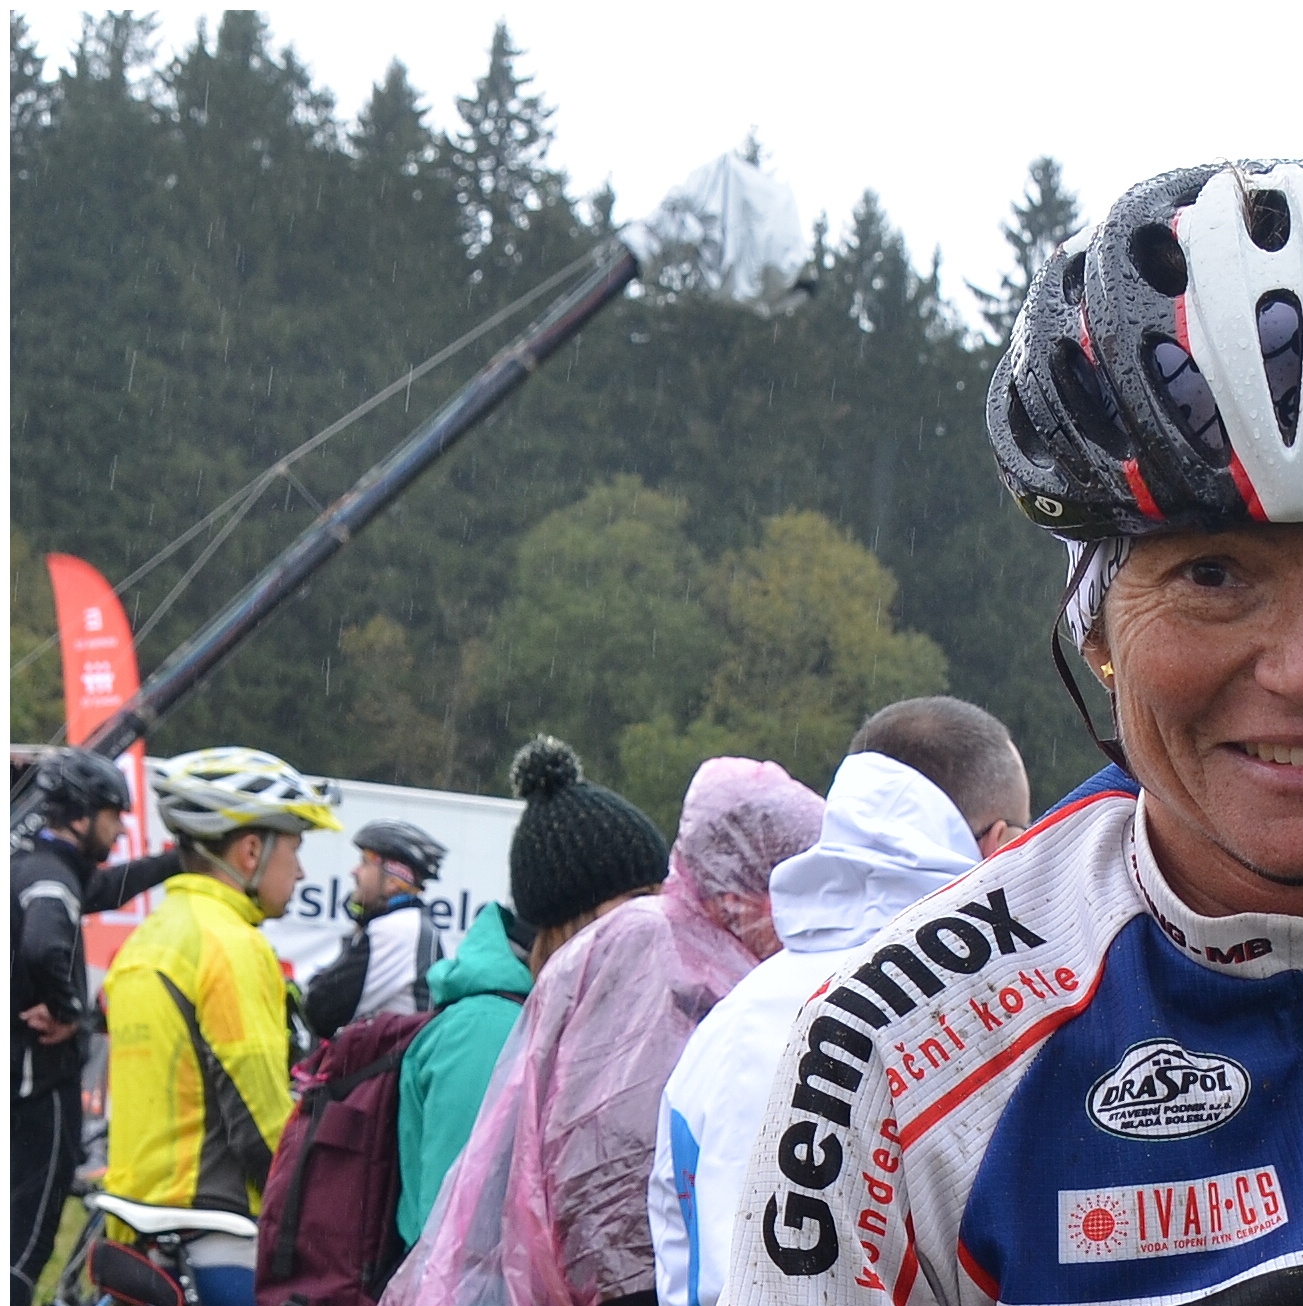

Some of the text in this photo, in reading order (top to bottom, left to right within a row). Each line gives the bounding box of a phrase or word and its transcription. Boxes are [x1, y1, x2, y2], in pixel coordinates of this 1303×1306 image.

[762, 887, 1047, 1278] Geminox
[854, 966, 1079, 1290] kondenační kotle
[1164, 1111, 1222, 1126] BOLESLAV
[1140, 1242, 1169, 1253] VODA
[1173, 1236, 1207, 1249] TOPENÍ
[1211, 1231, 1232, 1245] PLYN
